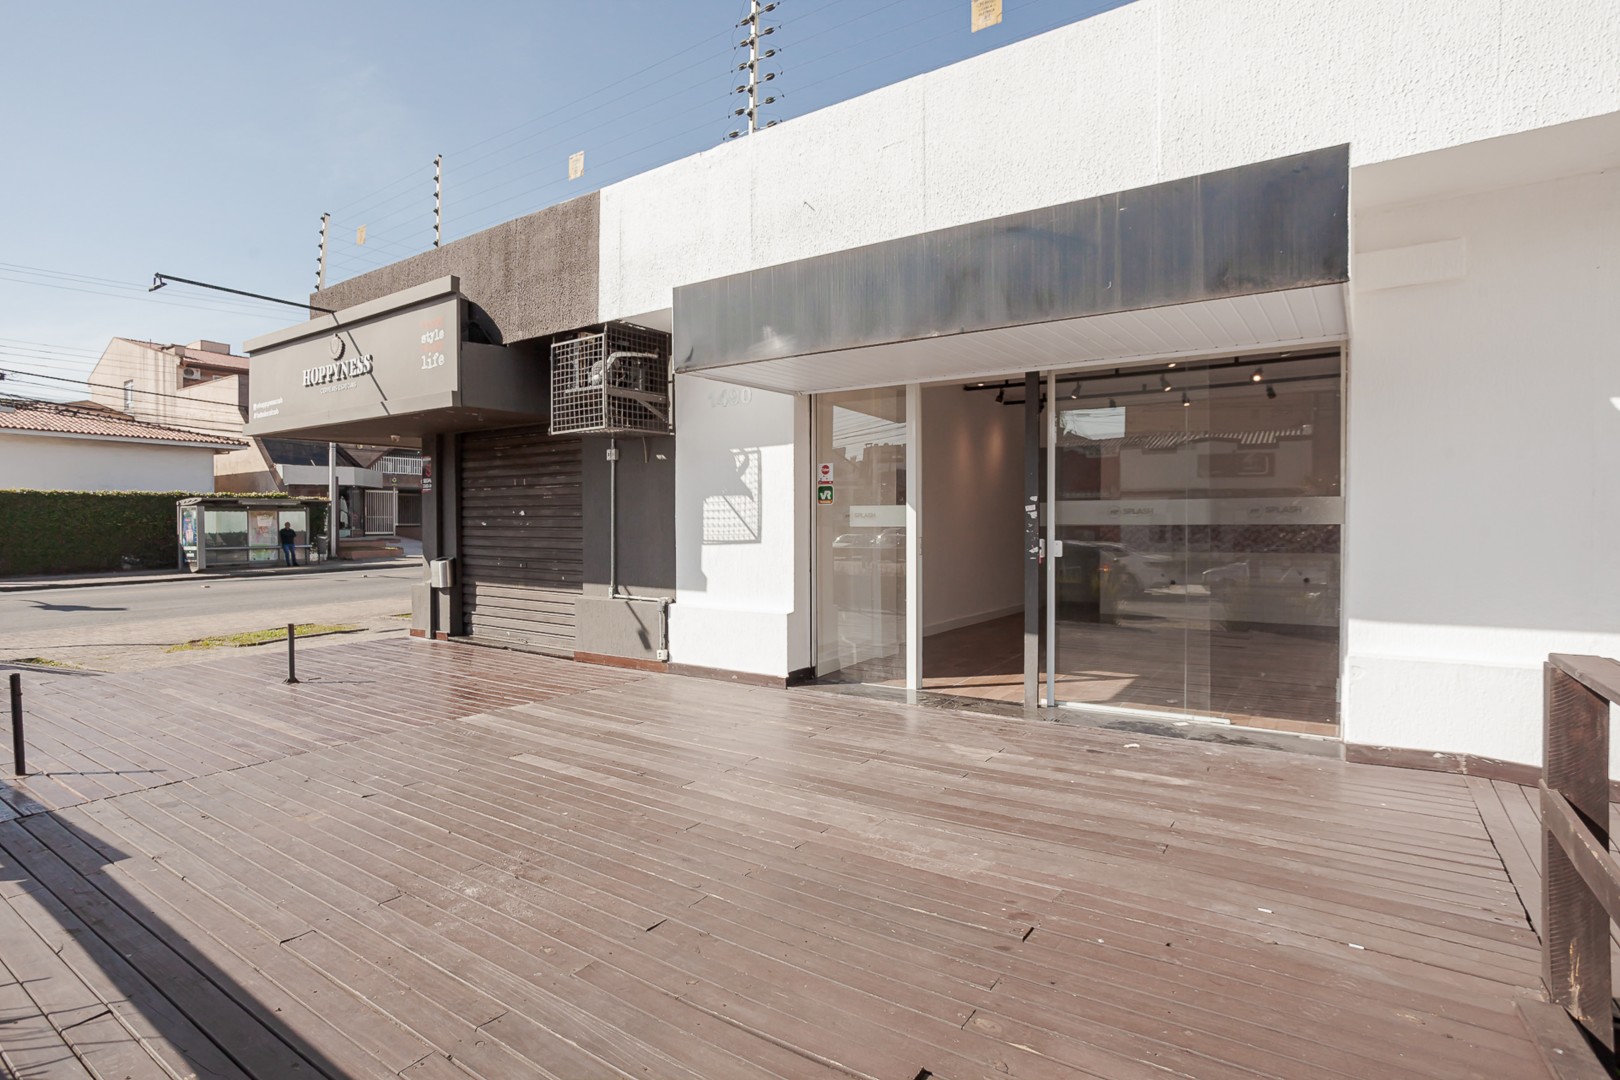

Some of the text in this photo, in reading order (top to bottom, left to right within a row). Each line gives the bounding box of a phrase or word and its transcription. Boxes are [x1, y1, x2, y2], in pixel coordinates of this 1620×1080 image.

[421, 328, 445, 344] style
[302, 354, 371, 386] HOPPYNESS
[420, 351, 446, 370] life
